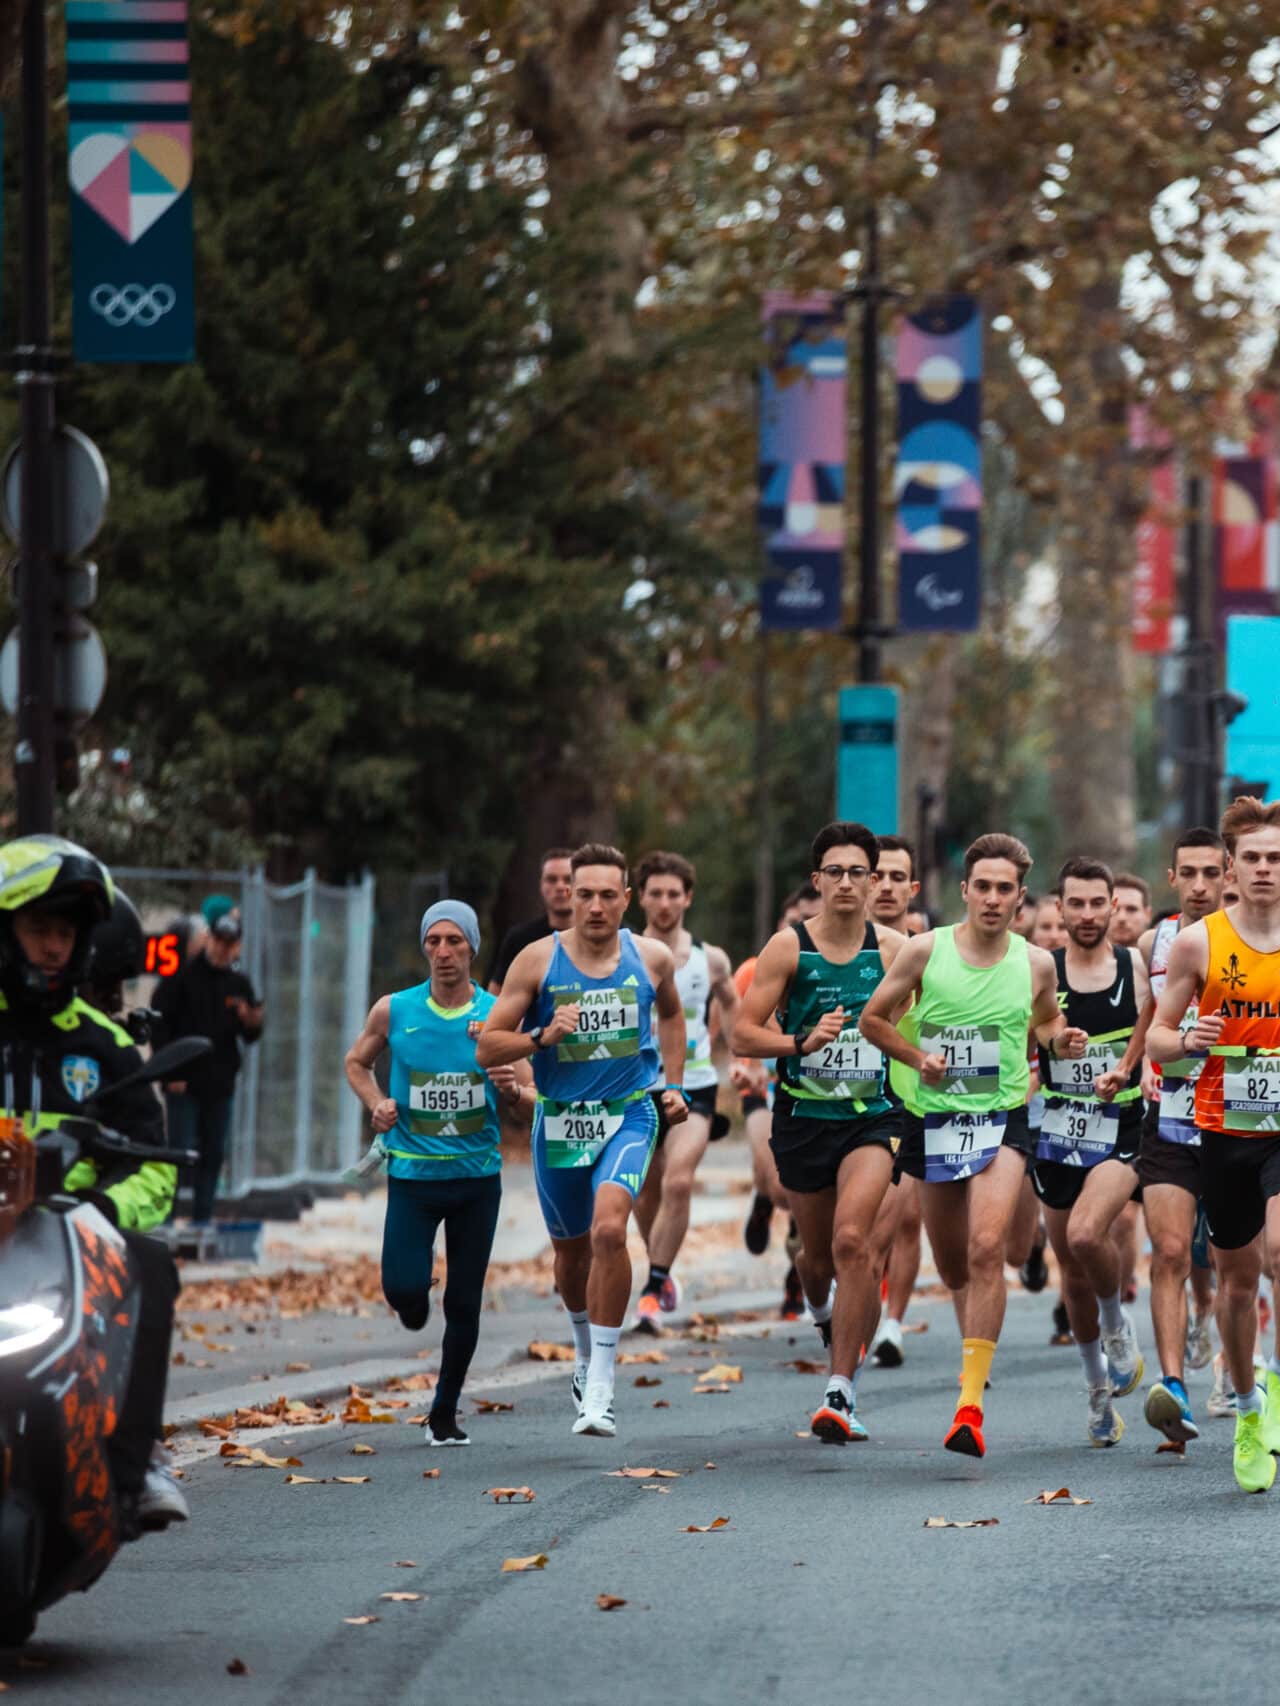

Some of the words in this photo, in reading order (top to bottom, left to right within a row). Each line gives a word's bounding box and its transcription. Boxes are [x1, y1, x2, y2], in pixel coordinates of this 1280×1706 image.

[581, 992, 617, 1006] MAIF
[575, 1008, 626, 1032] 034-1
[941, 1029, 979, 1041] MAIF
[822, 1047, 860, 1068] 24-1
[940, 1044, 972, 1066] 71-1
[1088, 1045, 1112, 1058] AIF
[432, 1073, 470, 1086] MAIF
[1071, 1061, 1108, 1083] 39-1
[421, 1089, 473, 1110] 1595-1
[564, 1119, 607, 1140] 2034
[951, 1114, 990, 1127] MAIF
[1067, 1116, 1087, 1138] 39
[959, 1132, 975, 1152] 71
